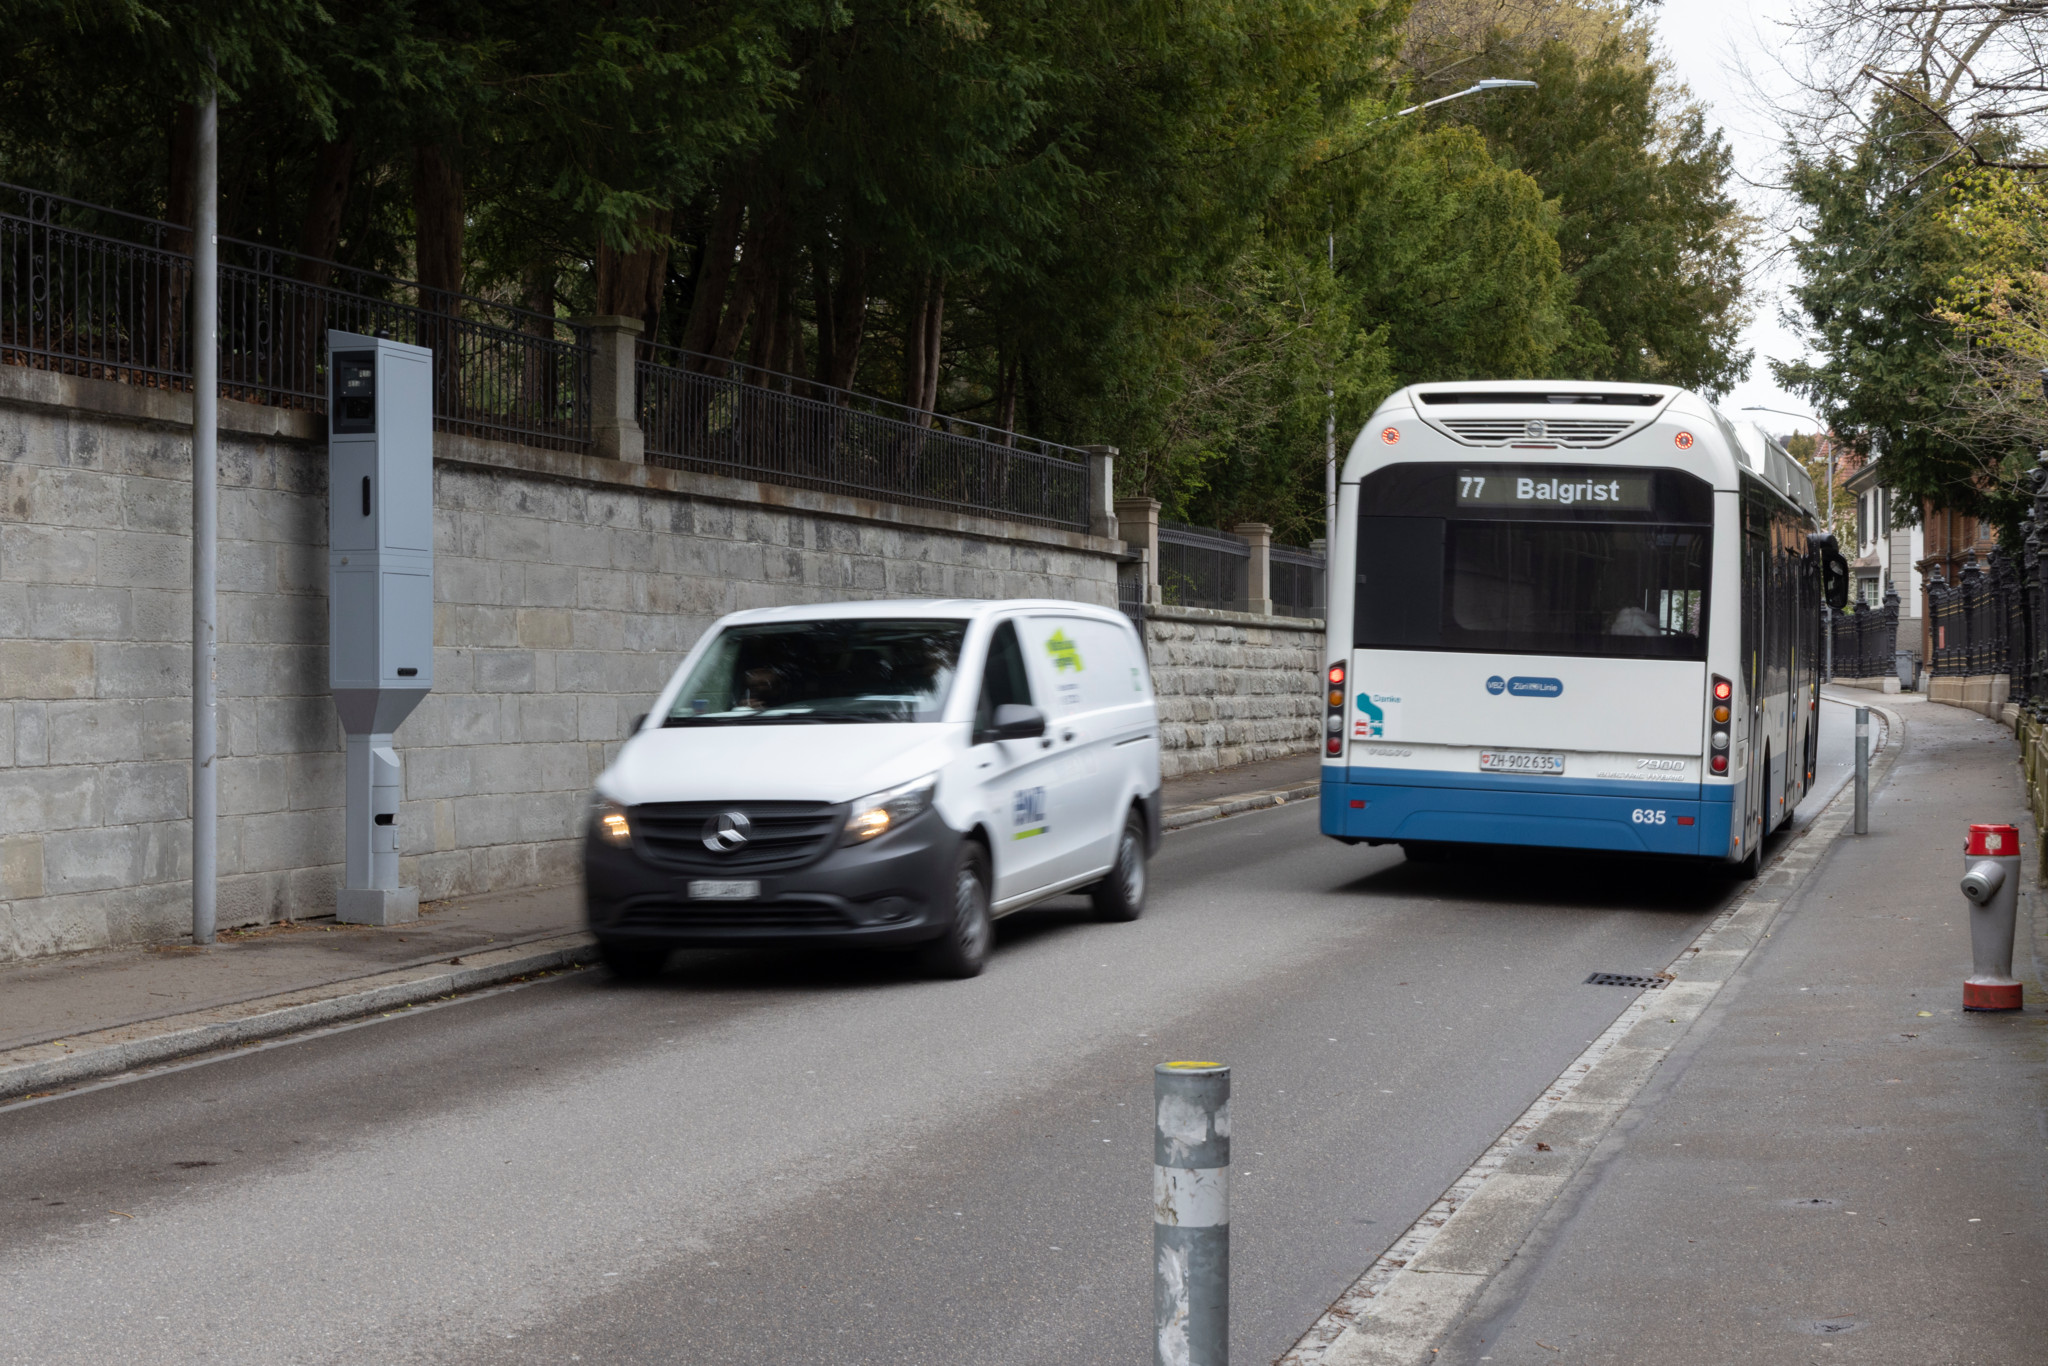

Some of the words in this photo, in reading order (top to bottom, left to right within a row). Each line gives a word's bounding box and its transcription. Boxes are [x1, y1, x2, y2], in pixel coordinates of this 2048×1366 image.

[1460, 476, 1486, 498] 77
[1516, 478, 1620, 504] Balgrist
[1637, 758, 1685, 771] 7900
[1631, 808, 1667, 825] 635
